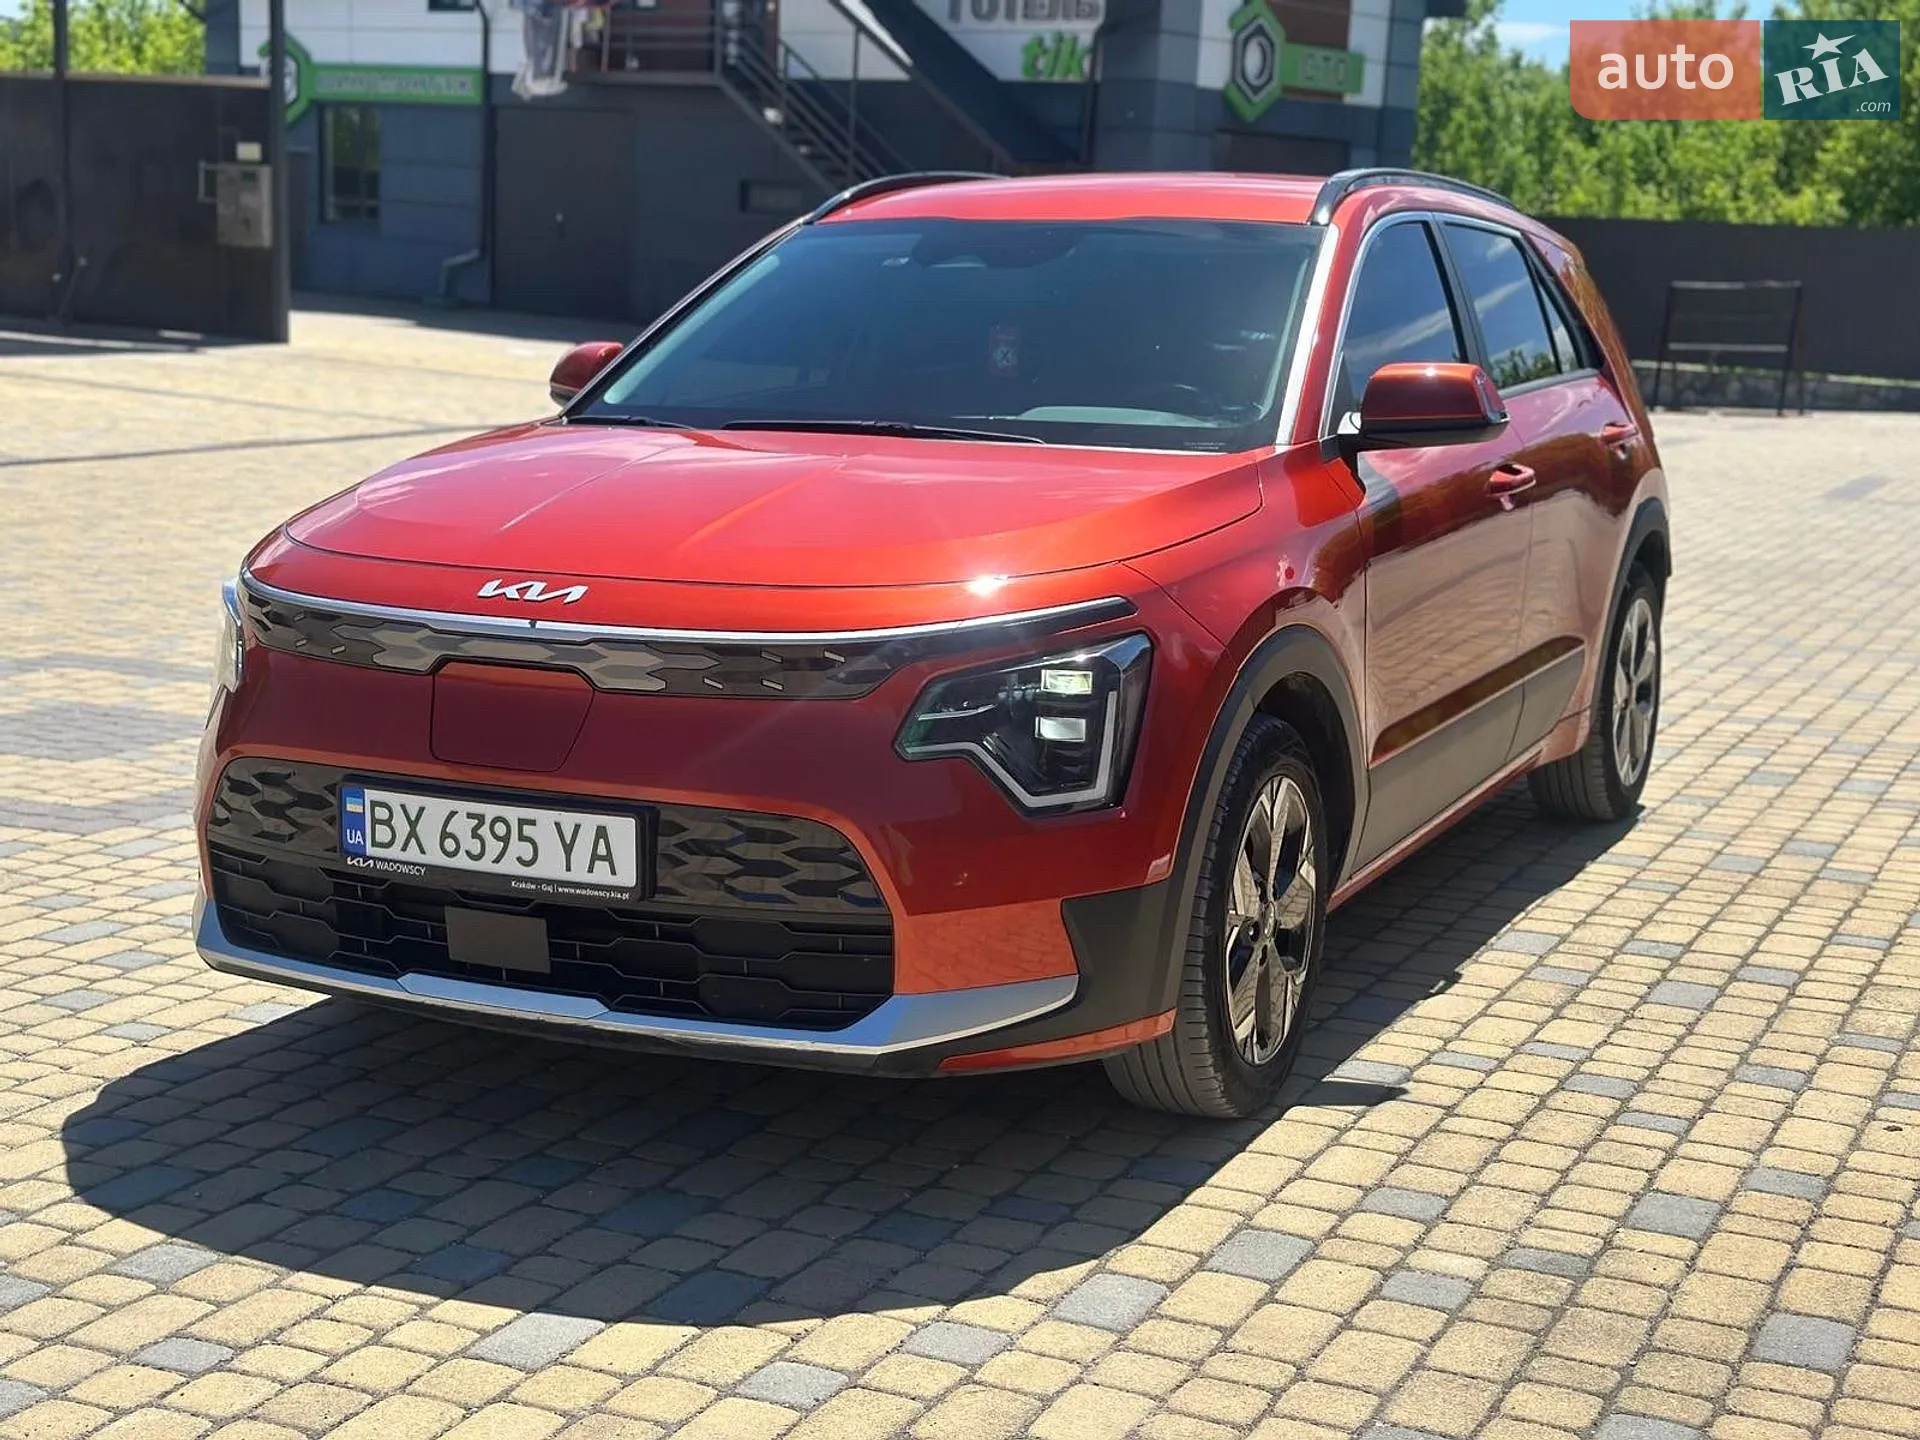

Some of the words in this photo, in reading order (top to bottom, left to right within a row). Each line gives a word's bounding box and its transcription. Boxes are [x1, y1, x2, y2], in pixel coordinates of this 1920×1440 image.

[477, 579, 588, 604] KIA
[346, 828, 364, 845] UA
[370, 800, 426, 855] BX
[439, 810, 538, 868] 6395
[554, 821, 617, 876] YA
[375, 860, 426, 876] WADOWSCY
